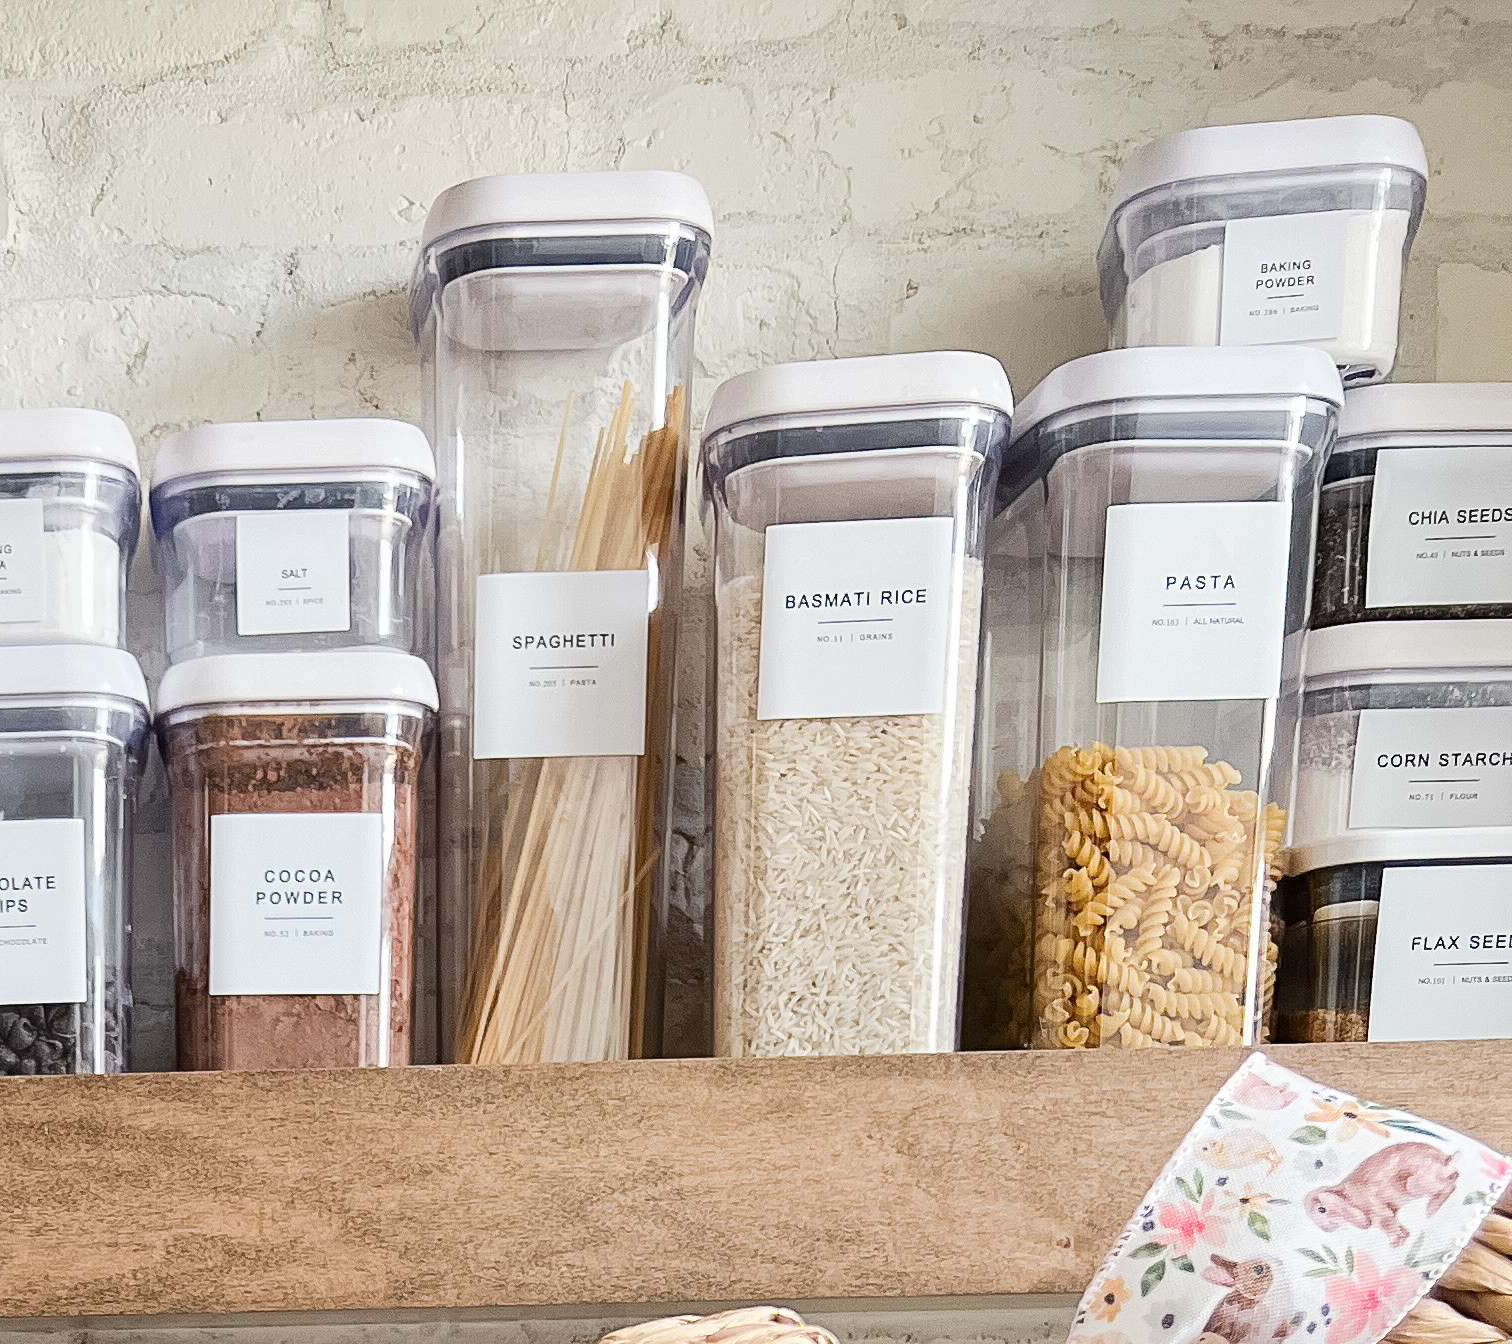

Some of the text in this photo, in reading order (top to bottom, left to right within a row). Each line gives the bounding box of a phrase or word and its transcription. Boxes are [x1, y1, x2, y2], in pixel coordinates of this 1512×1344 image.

[1260, 259, 1312, 274] BAKING
[1255, 275, 1315, 290] POWDER
[1408, 507, 1512, 526] CHIA SEEDS
[281, 568, 308, 579] SALT
[1165, 574, 1236, 591] PASTA
[785, 588, 927, 609] BASMATI RICE
[1209, 616, 1245, 626] NATURAL
[512, 633, 616, 650] SPAGHETTI
[859, 632, 894, 642] GRAINS
[570, 678, 597, 687] PASTA
[1377, 751, 1512, 768] CORN STARCH
[1449, 792, 1479, 800] FLOUR
[264, 869, 336, 884] COCOA
[255, 890, 344, 905] POWDER
[1411, 935, 1460, 951] FLAX
